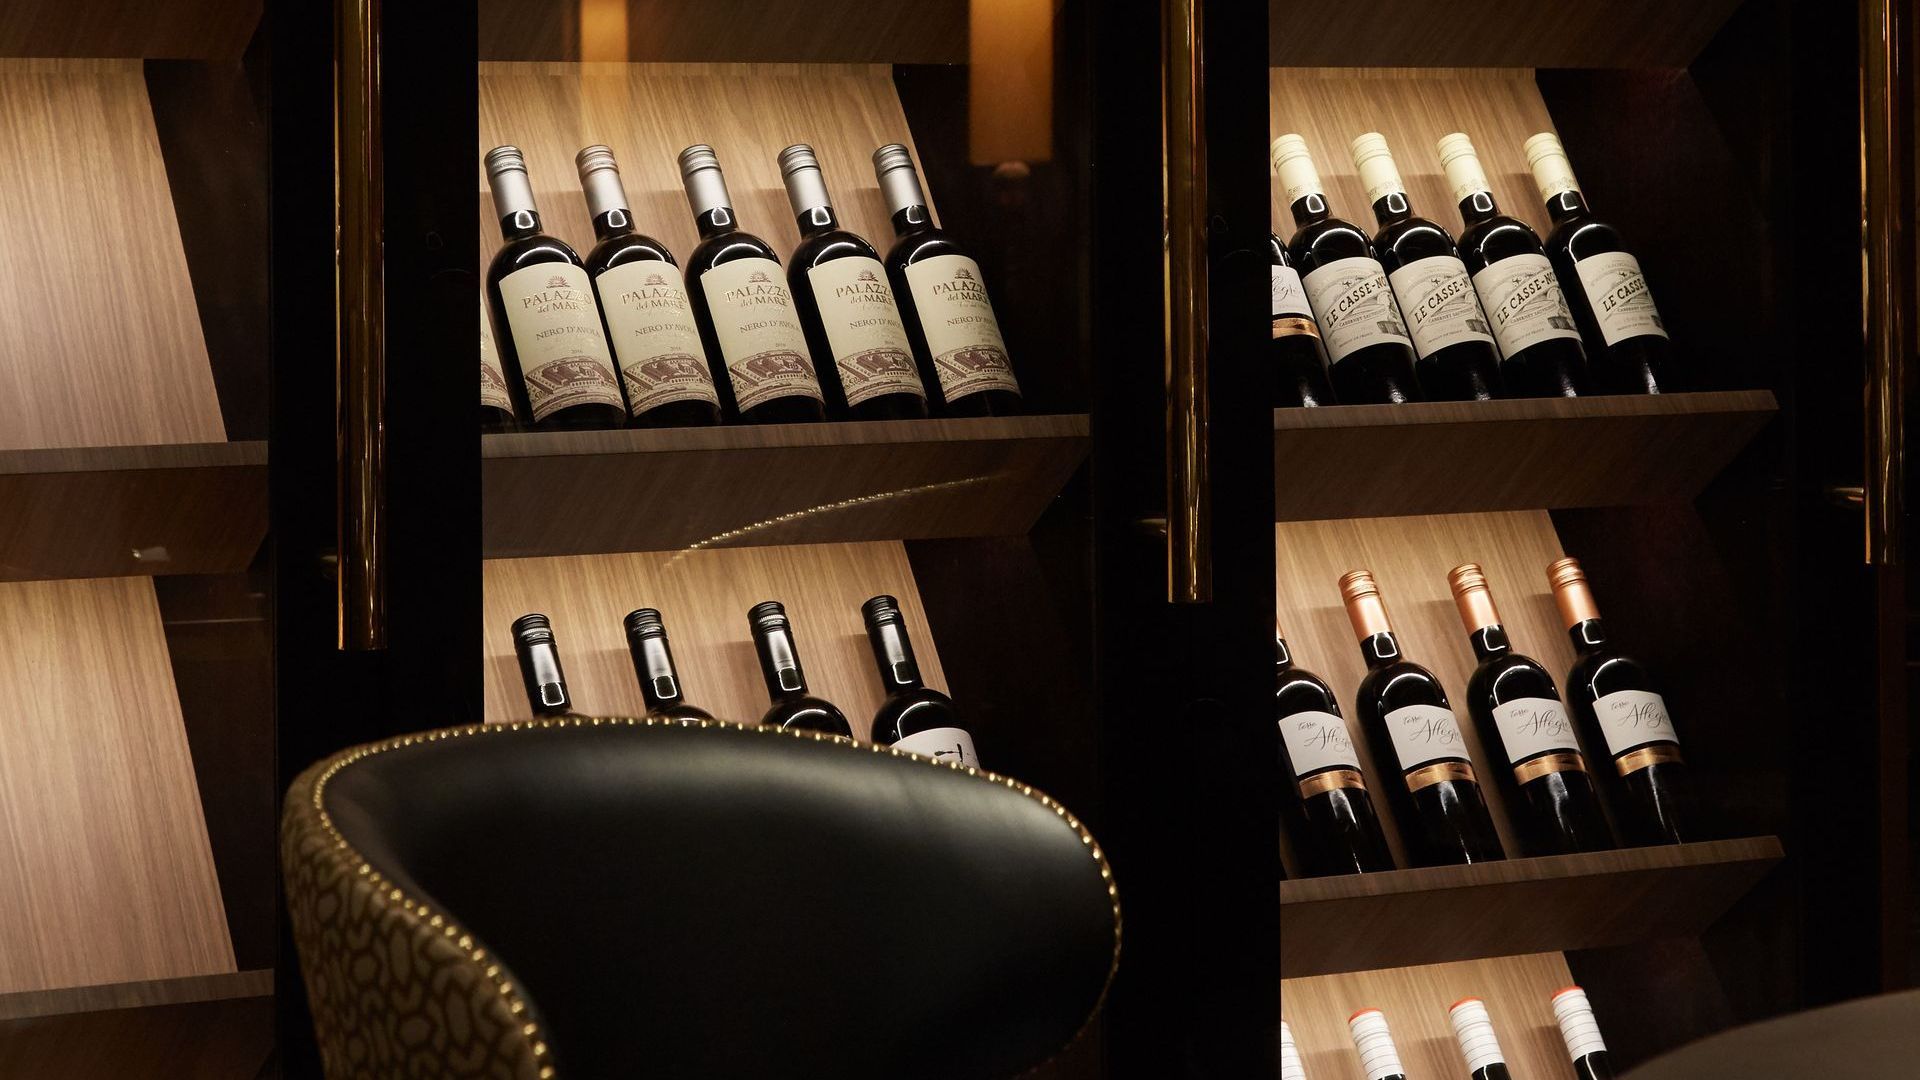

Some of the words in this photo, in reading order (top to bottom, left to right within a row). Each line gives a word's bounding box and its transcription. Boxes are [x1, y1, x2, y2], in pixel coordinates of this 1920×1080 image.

[521, 290, 593, 308] PALAZZO
[622, 288, 688, 304] PALAZZO
[726, 284, 791, 301] PALAZZO
[948, 293, 959, 301] del
[961, 292, 990, 305] MARE
[1497, 307, 1509, 325] LE
[1510, 272, 1556, 309] CASSE-NO
[651, 299, 685, 310] MARE
[755, 296, 788, 307] MARE
[851, 296, 861, 304] del
[864, 294, 893, 306] MARE
[1326, 309, 1338, 328] LE
[1339, 276, 1388, 312] CASSE-NO
[1603, 295, 1617, 312] LE
[947, 316, 974, 326] NERO
[1414, 305, 1427, 324] LE
[635, 324, 663, 336] NERO
[740, 322, 768, 333] NERO
[850, 319, 877, 329] NERO
[536, 327, 564, 340] NERO
[1517, 709, 1571, 736] Allegre
